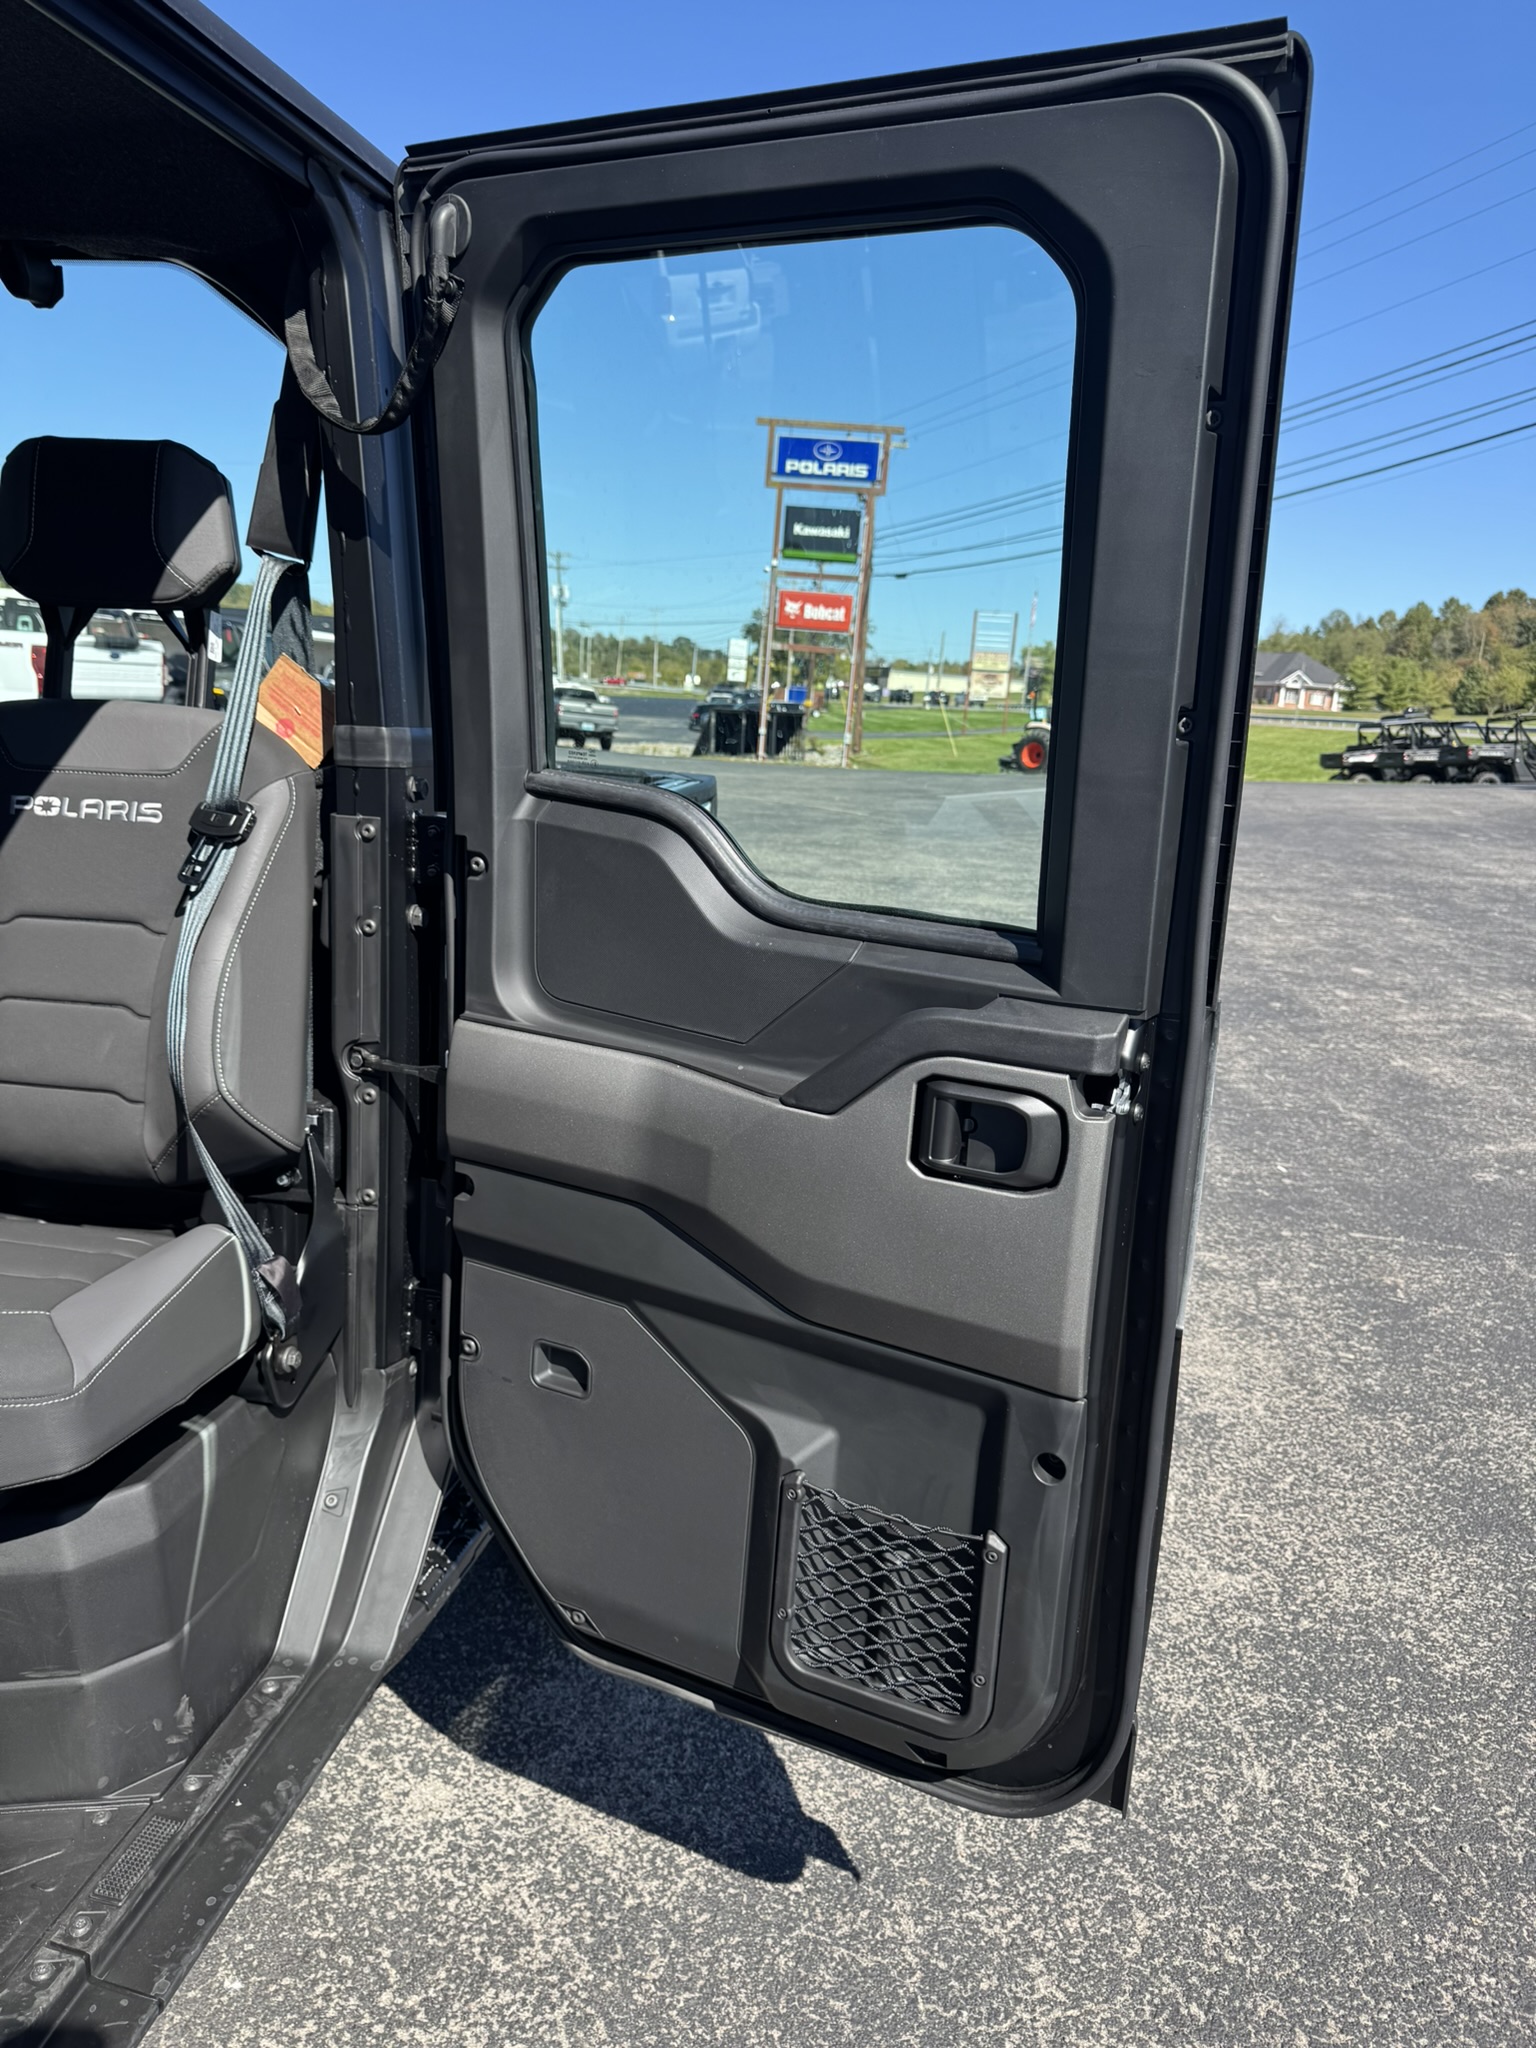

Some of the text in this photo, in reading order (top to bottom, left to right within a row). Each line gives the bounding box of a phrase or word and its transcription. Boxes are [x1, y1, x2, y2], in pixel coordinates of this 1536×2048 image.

[785, 458, 869, 479] POLARIS
[793, 521, 851, 540] Kawasaki
[803, 602, 847, 622] Bobcat
[10, 795, 163, 824] POLARIS
